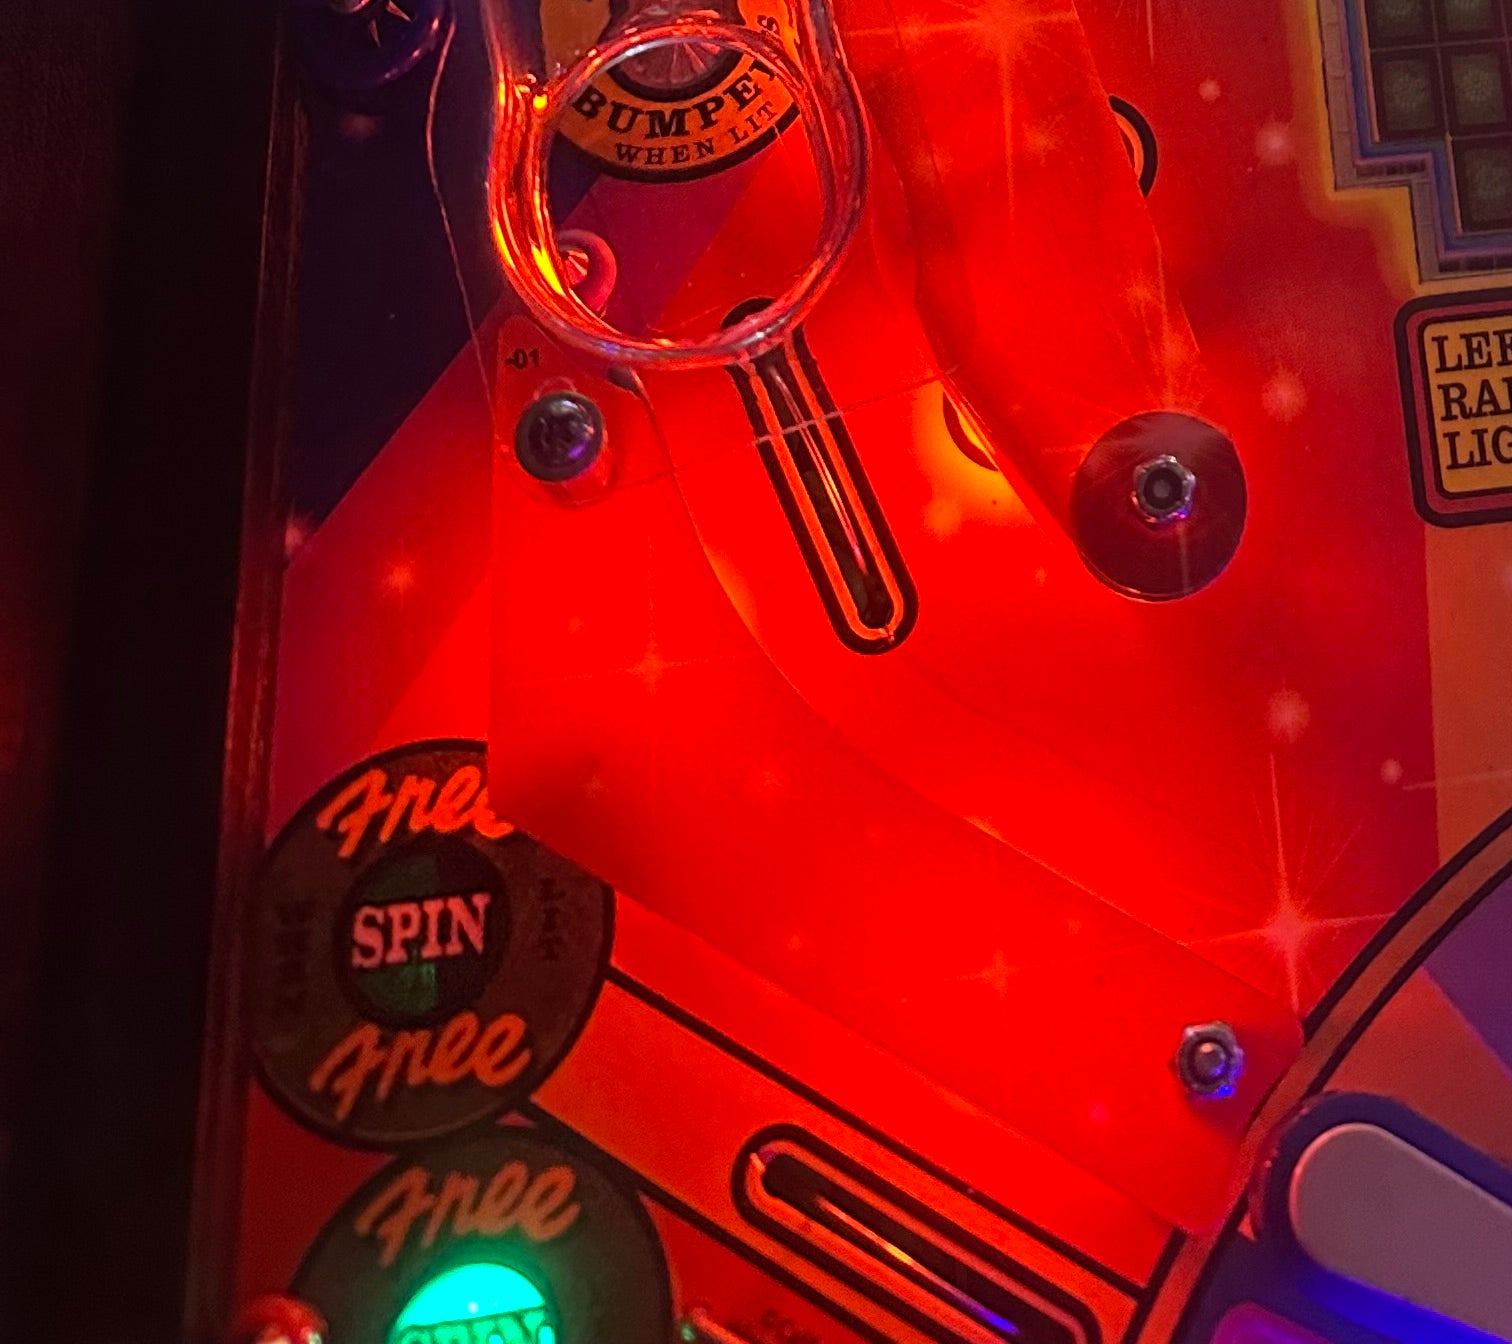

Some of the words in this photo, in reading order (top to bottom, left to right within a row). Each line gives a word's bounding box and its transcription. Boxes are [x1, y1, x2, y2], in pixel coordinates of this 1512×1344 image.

[615, 135, 716, 166] WHEN
[728, 101, 778, 145] LIT
[351, 891, 493, 970] SPIN
